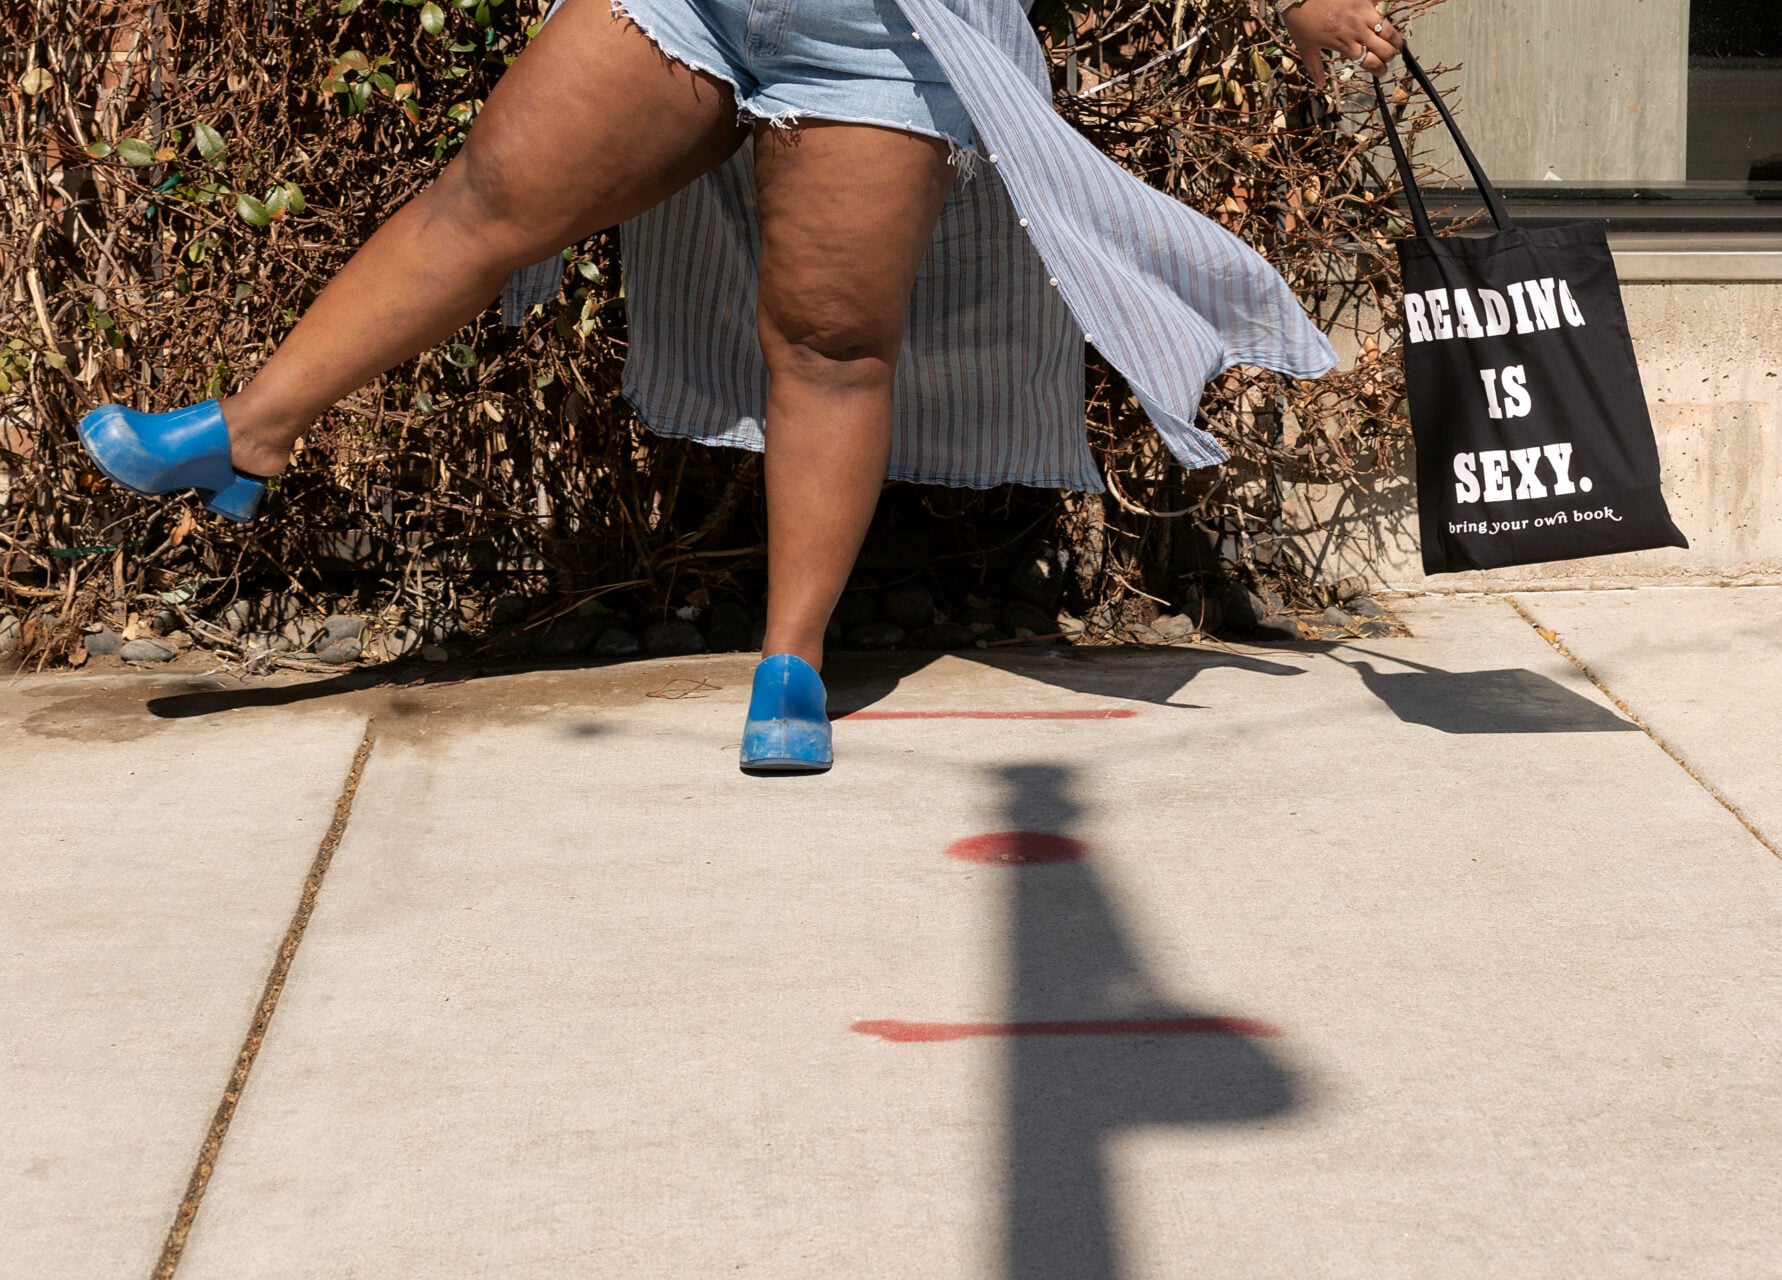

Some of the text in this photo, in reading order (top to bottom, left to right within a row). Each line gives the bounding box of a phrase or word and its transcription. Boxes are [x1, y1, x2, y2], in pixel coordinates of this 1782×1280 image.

[1403, 277, 1586, 344] READING
[1479, 364, 1532, 420] IS
[1453, 442, 1593, 504] SEXY.
[1449, 505, 1623, 535] bring your own book
